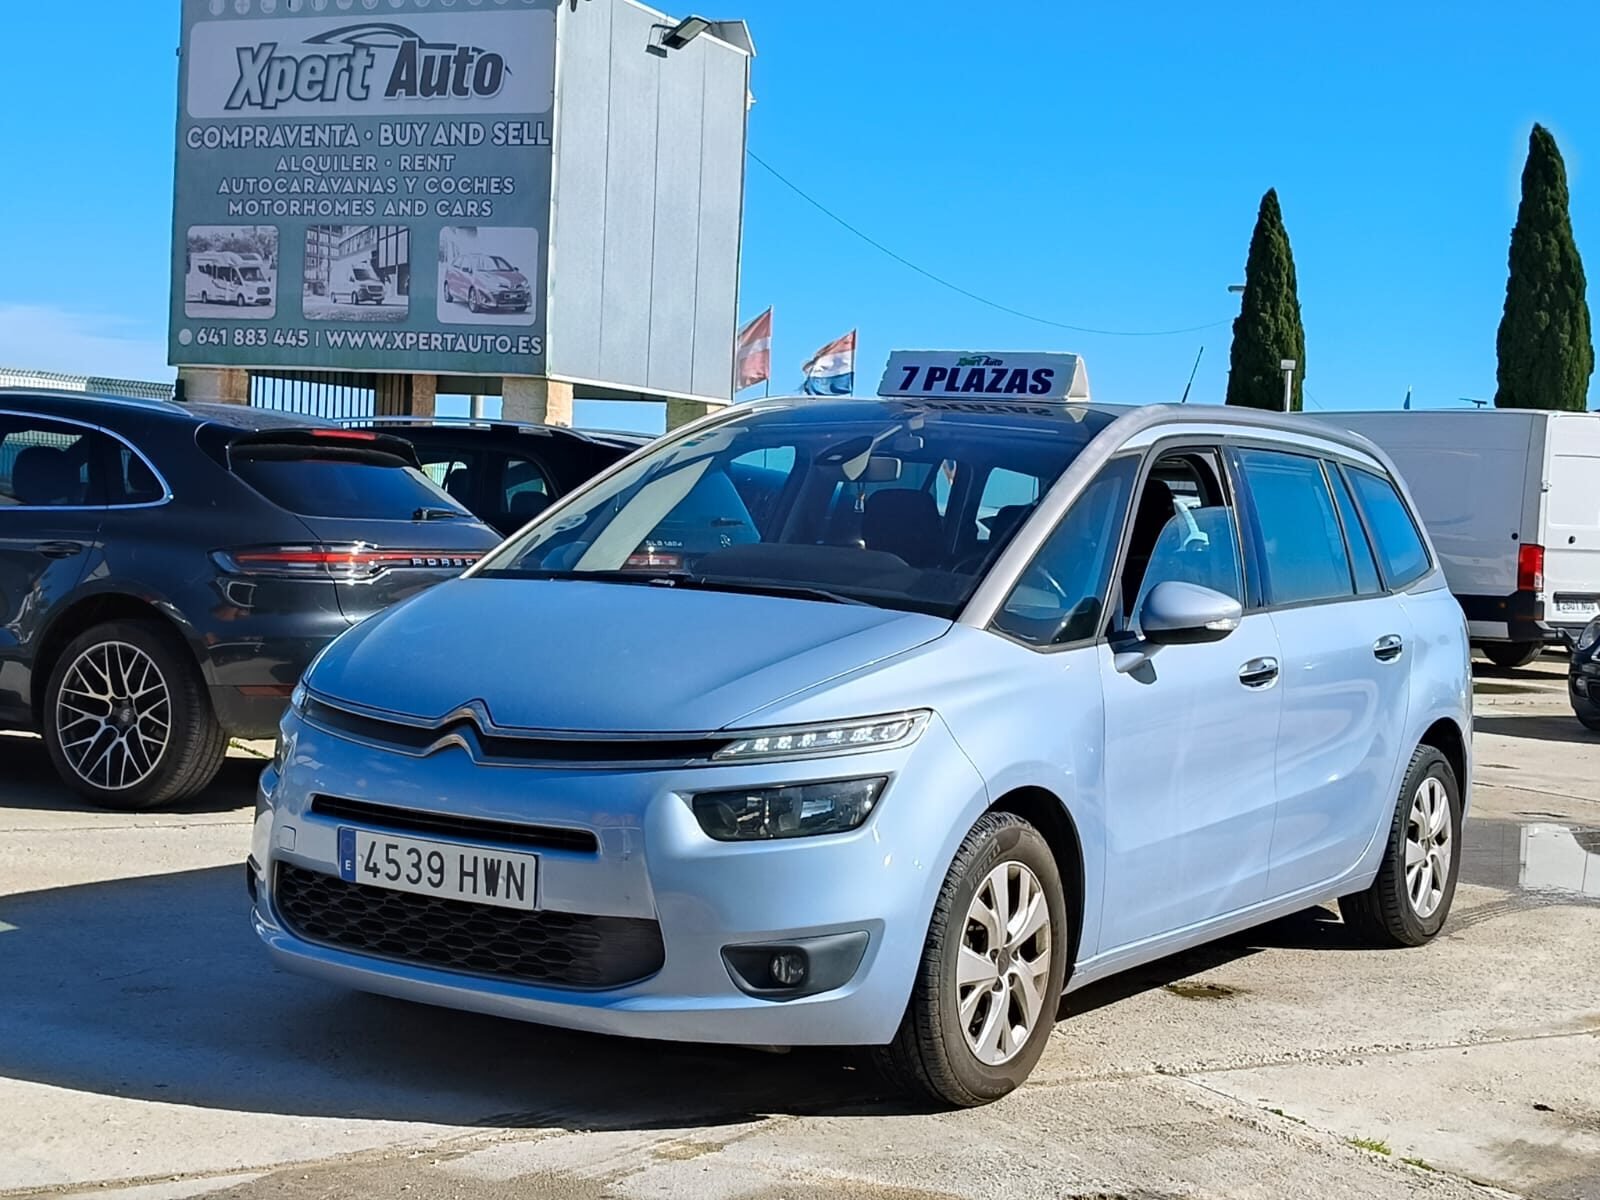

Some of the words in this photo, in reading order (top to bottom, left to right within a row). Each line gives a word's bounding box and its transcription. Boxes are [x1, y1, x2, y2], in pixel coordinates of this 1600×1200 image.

[224, 42, 374, 110] Xpert
[384, 40, 504, 98] Auto
[186, 124, 360, 150] COMPRAVENTA
[377, 123, 429, 147] BUY
[432, 122, 486, 146] AND
[491, 121, 550, 147] SELL
[275, 155, 377, 175] ALQUILER
[399, 155, 455, 171] RENT
[218, 177, 398, 195] AUTOCARAVANAS
[405, 177, 417, 193] Y
[424, 177, 515, 195] COCHES
[228, 199, 375, 217] MOTORHOMES
[383, 199, 428, 216] AND
[435, 199, 493, 217] CARS
[197, 328, 227, 347] 641
[233, 329, 268, 347] 883
[274, 329, 309, 348] 445
[325, 331, 543, 354] WWW.XPERTAUTO.ES
[899, 366, 920, 390] 7
[923, 366, 1054, 394] PLAZAS
[412, 557, 475, 566] PORSC
[345, 860, 351, 871] E
[364, 841, 445, 888] 4539
[459, 854, 526, 902] HWN
